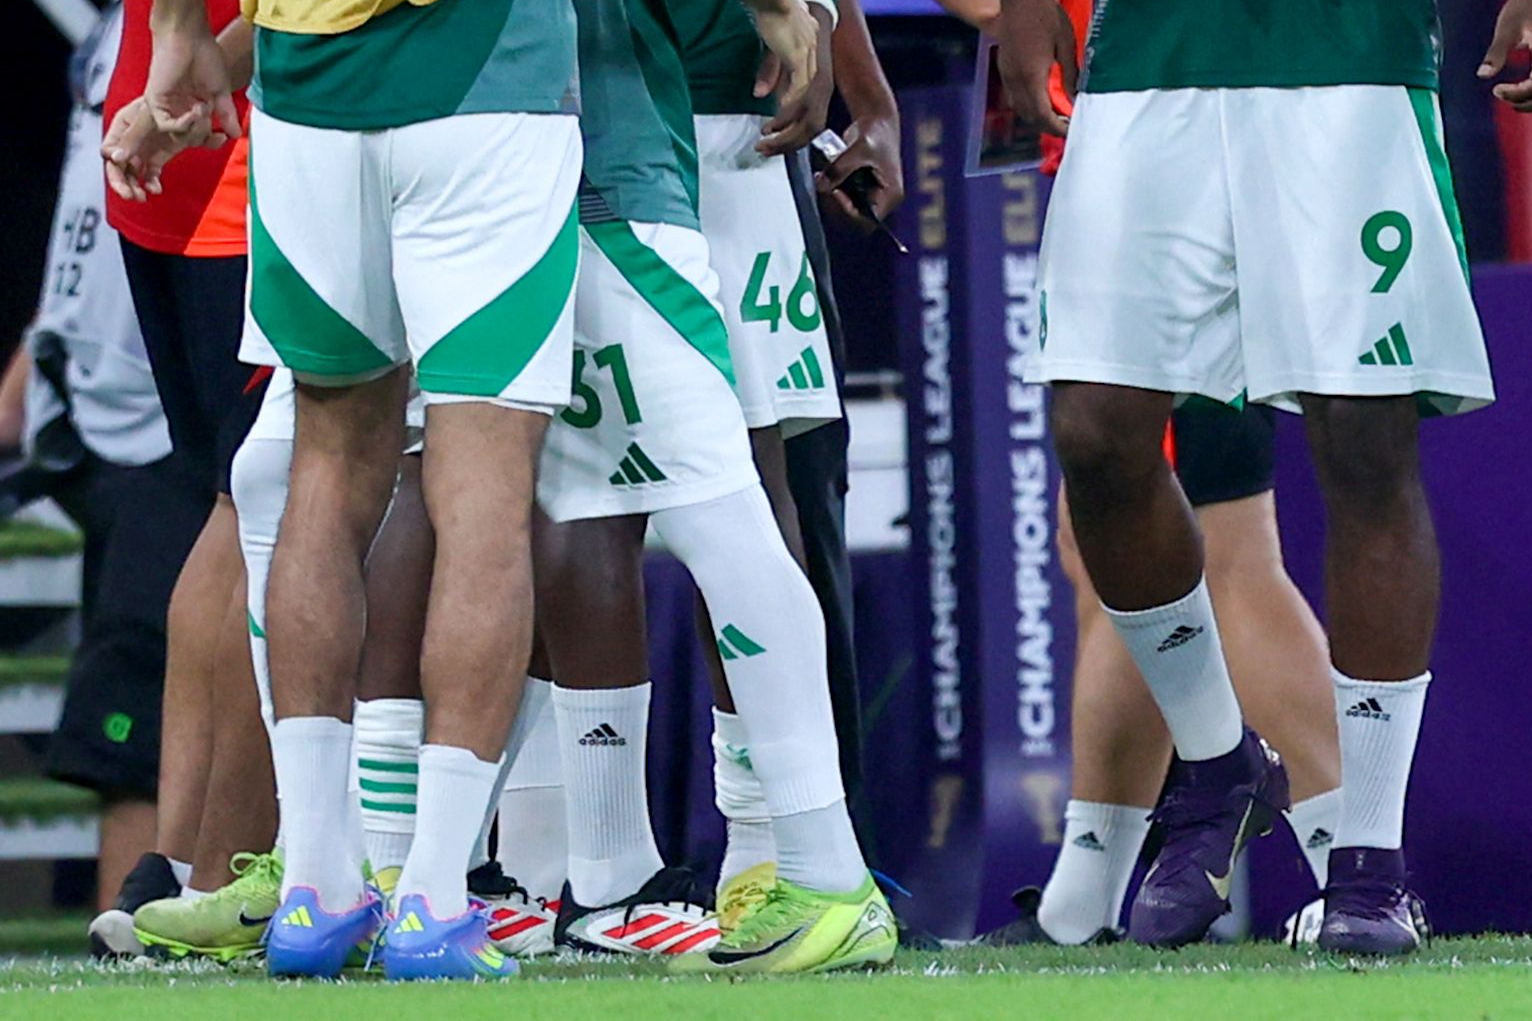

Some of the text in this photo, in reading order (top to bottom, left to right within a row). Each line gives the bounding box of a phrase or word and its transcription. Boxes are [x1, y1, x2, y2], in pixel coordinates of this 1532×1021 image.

[741, 251, 820, 333] 46
[1360, 210, 1412, 293] 9
[919, 254, 953, 444] LEAGUE
[925, 449, 963, 742] CHAMPIONS
[1010, 445, 1054, 740] CHAMPIONS
[579, 737, 626, 746] adidas
